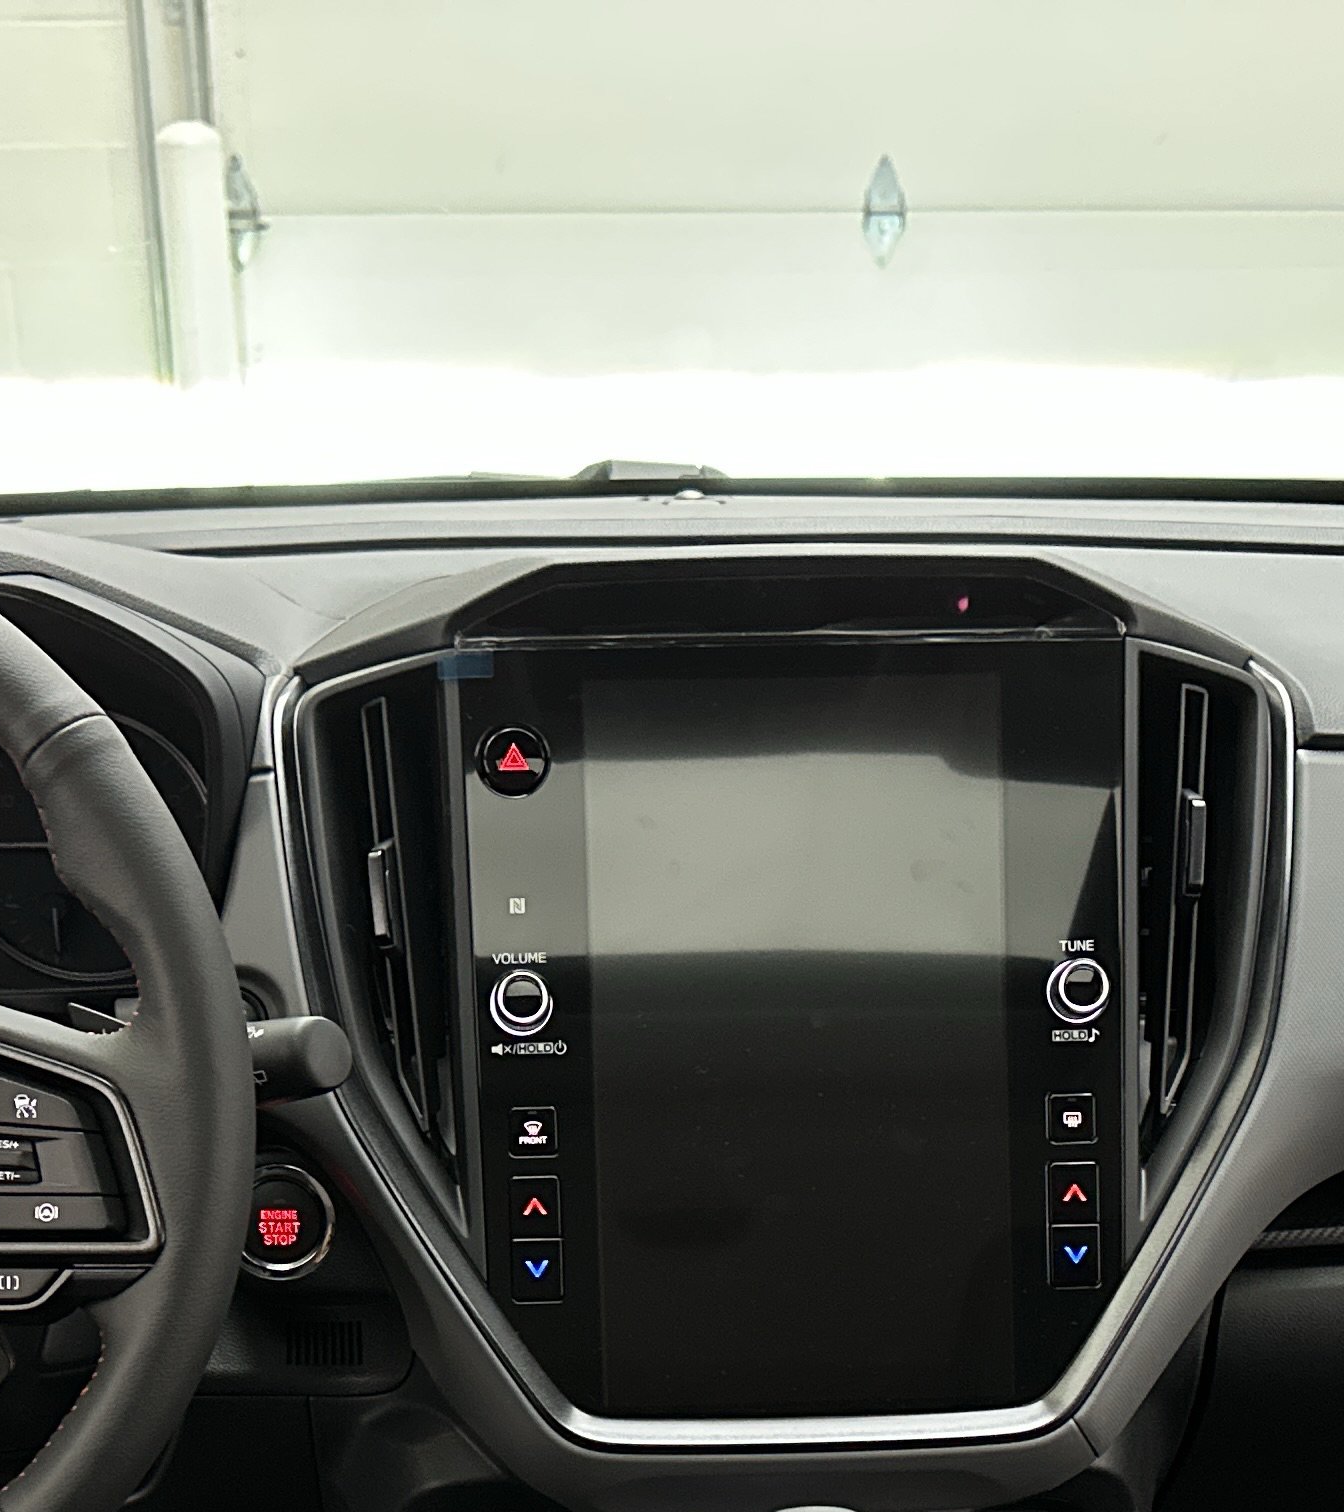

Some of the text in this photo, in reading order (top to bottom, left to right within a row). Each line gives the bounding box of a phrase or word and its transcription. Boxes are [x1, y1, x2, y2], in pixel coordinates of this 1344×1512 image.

[1059, 939, 1095, 952] TUNE
[491, 952, 547, 965] VOLUME
[1053, 1029, 1087, 1042] HOLD
[518, 1135, 548, 1145] FRONT
[260, 1210, 298, 1220] ENGINE
[258, 1222, 301, 1233] START
[263, 1234, 297, 1246] STOP
